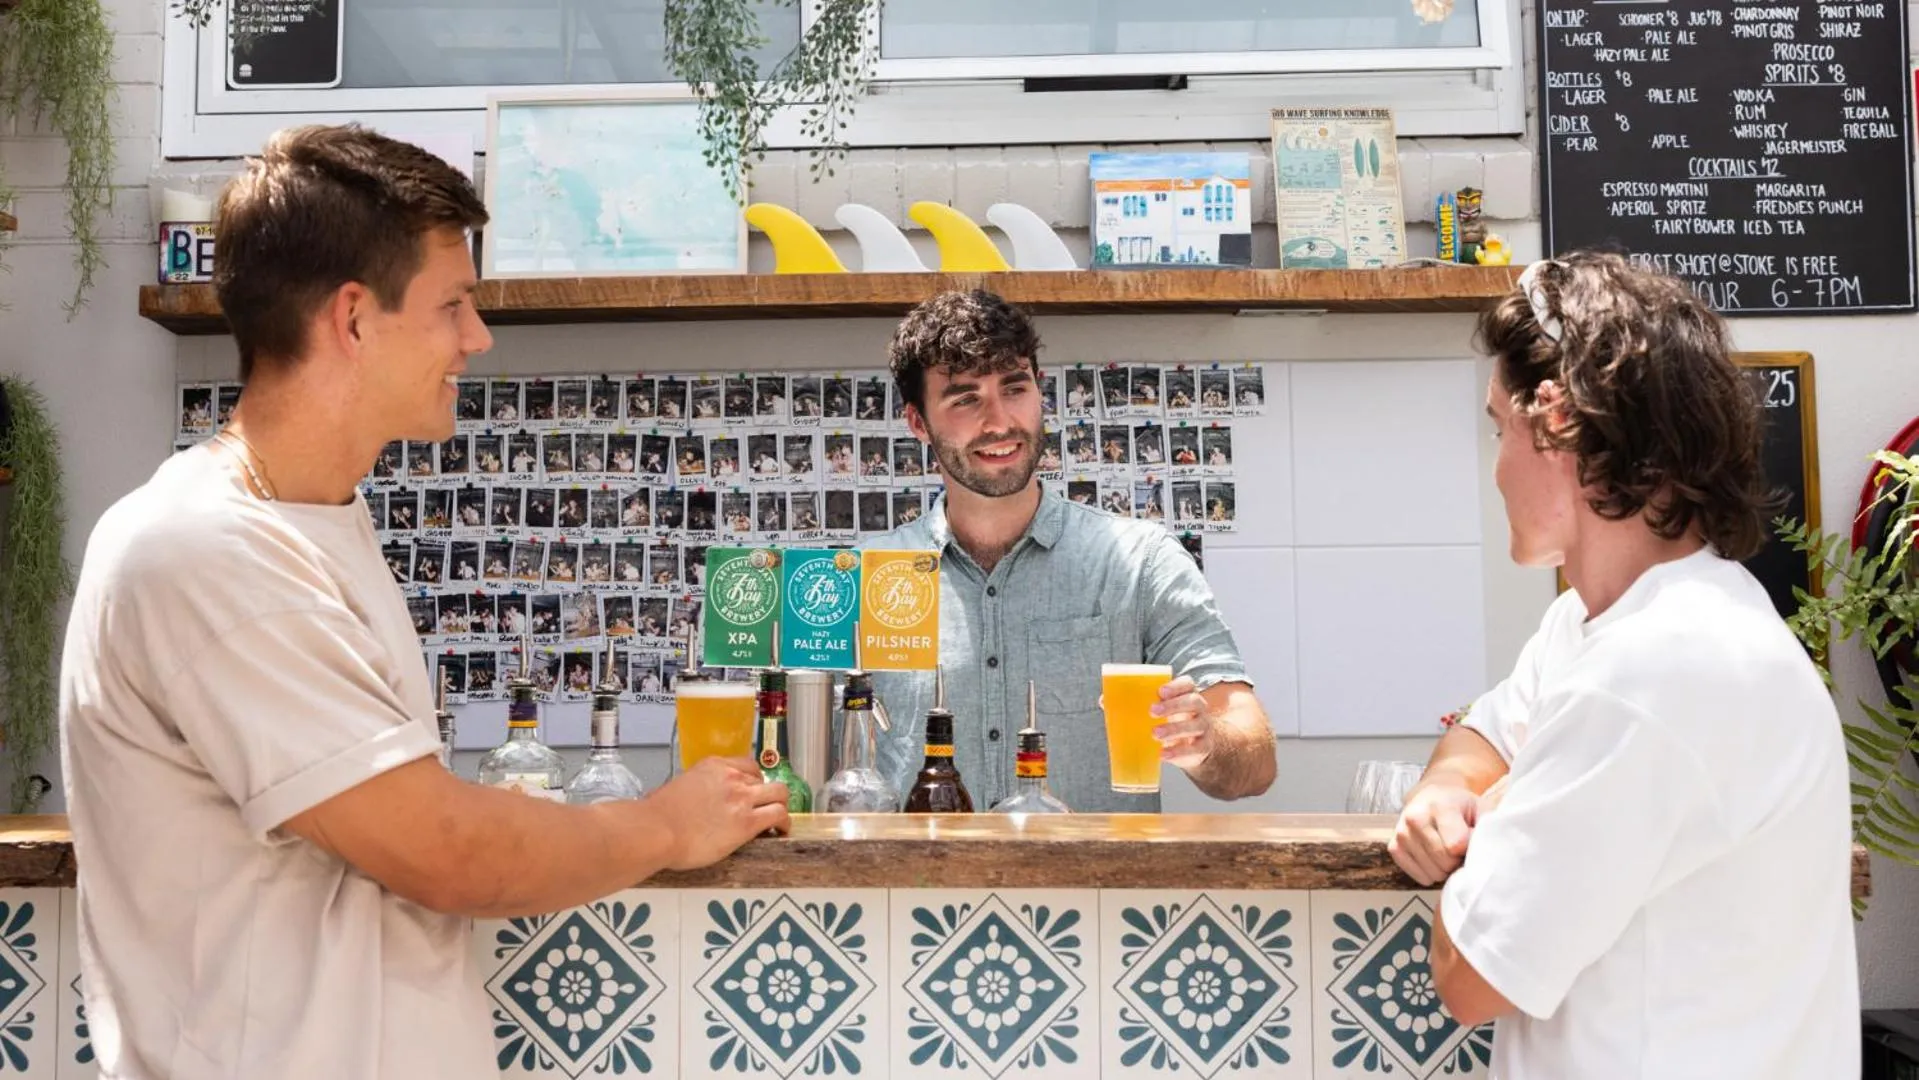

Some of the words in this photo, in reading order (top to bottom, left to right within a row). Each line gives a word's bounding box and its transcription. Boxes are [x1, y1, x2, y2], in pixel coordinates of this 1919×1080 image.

[1546, 10, 1562, 26] ON
[1619, 12, 1665, 26] SCHOONER
[1687, 12, 1707, 26] JUG
[1734, 7, 1800, 21] CHARDONNAY
[1819, 5, 1853, 19] PINOT
[1856, 4, 1885, 18] NOIR
[1645, 30, 1672, 45] PALE
[1677, 30, 1698, 45] ALE
[1734, 24, 1767, 38] PINOT
[1769, 24, 1795, 39] GRIS
[1819, 22, 1862, 38] SHIRAZ
[1565, 32, 1604, 47] LAGER
[1594, 48, 1621, 62] HAZY
[1623, 48, 1648, 62] PALE
[1651, 48, 1671, 62] ALE
[1773, 43, 1835, 61] PROSECCO
[1548, 71, 1602, 87] BOTTLES
[1615, 69, 1633, 87] $8
[1764, 64, 1820, 84] SPIRITS
[1828, 64, 1846, 83] $8
[1565, 89, 1607, 106] LAGER
[1648, 88, 1675, 103] PALE
[1677, 88, 1698, 103] ALE
[1733, 89, 1775, 103] VODKA
[1843, 88, 1866, 101] GIN
[1735, 104, 1766, 120] RUM
[1843, 107, 1889, 119] TEQUILA
[1550, 115, 1592, 134] CIDER
[1615, 112, 1631, 132] $8
[1733, 123, 1788, 139] WHISKEY
[1566, 137, 1599, 151] PEAR
[1651, 135, 1690, 149] APPLE
[1764, 139, 1848, 155] JAGERMEISTER
[1688, 157, 1758, 178] COCKTAILS
[1603, 183, 1657, 197] ESPRESSO
[1661, 183, 1708, 197] MARTINI
[1756, 183, 1825, 197] MARGARITA
[1611, 201, 1658, 216] APEROL
[1667, 201, 1707, 215] SPRITZ
[1756, 200, 1814, 215] FREDDIES
[1819, 199, 1863, 214] PUNCH
[1440, 203, 1454, 260] ELCOME
[1744, 220, 1772, 234] ICED
[1778, 221, 1805, 234] TEA
[1786, 256, 1799, 275] IS
[1803, 255, 1840, 275] FREE
[1692, 280, 1741, 308] OUR
[717, 559, 754, 581] SEVENT
[795, 560, 833, 583] SEVENTH
[721, 605, 766, 622] BREWERY
[798, 607, 844, 623] BREWERY
[876, 608, 921, 625] BREWERY
[728, 632, 757, 645] XPA
[794, 639, 822, 650] PALE
[825, 639, 848, 650] ALE
[866, 635, 932, 649] PILSNER
